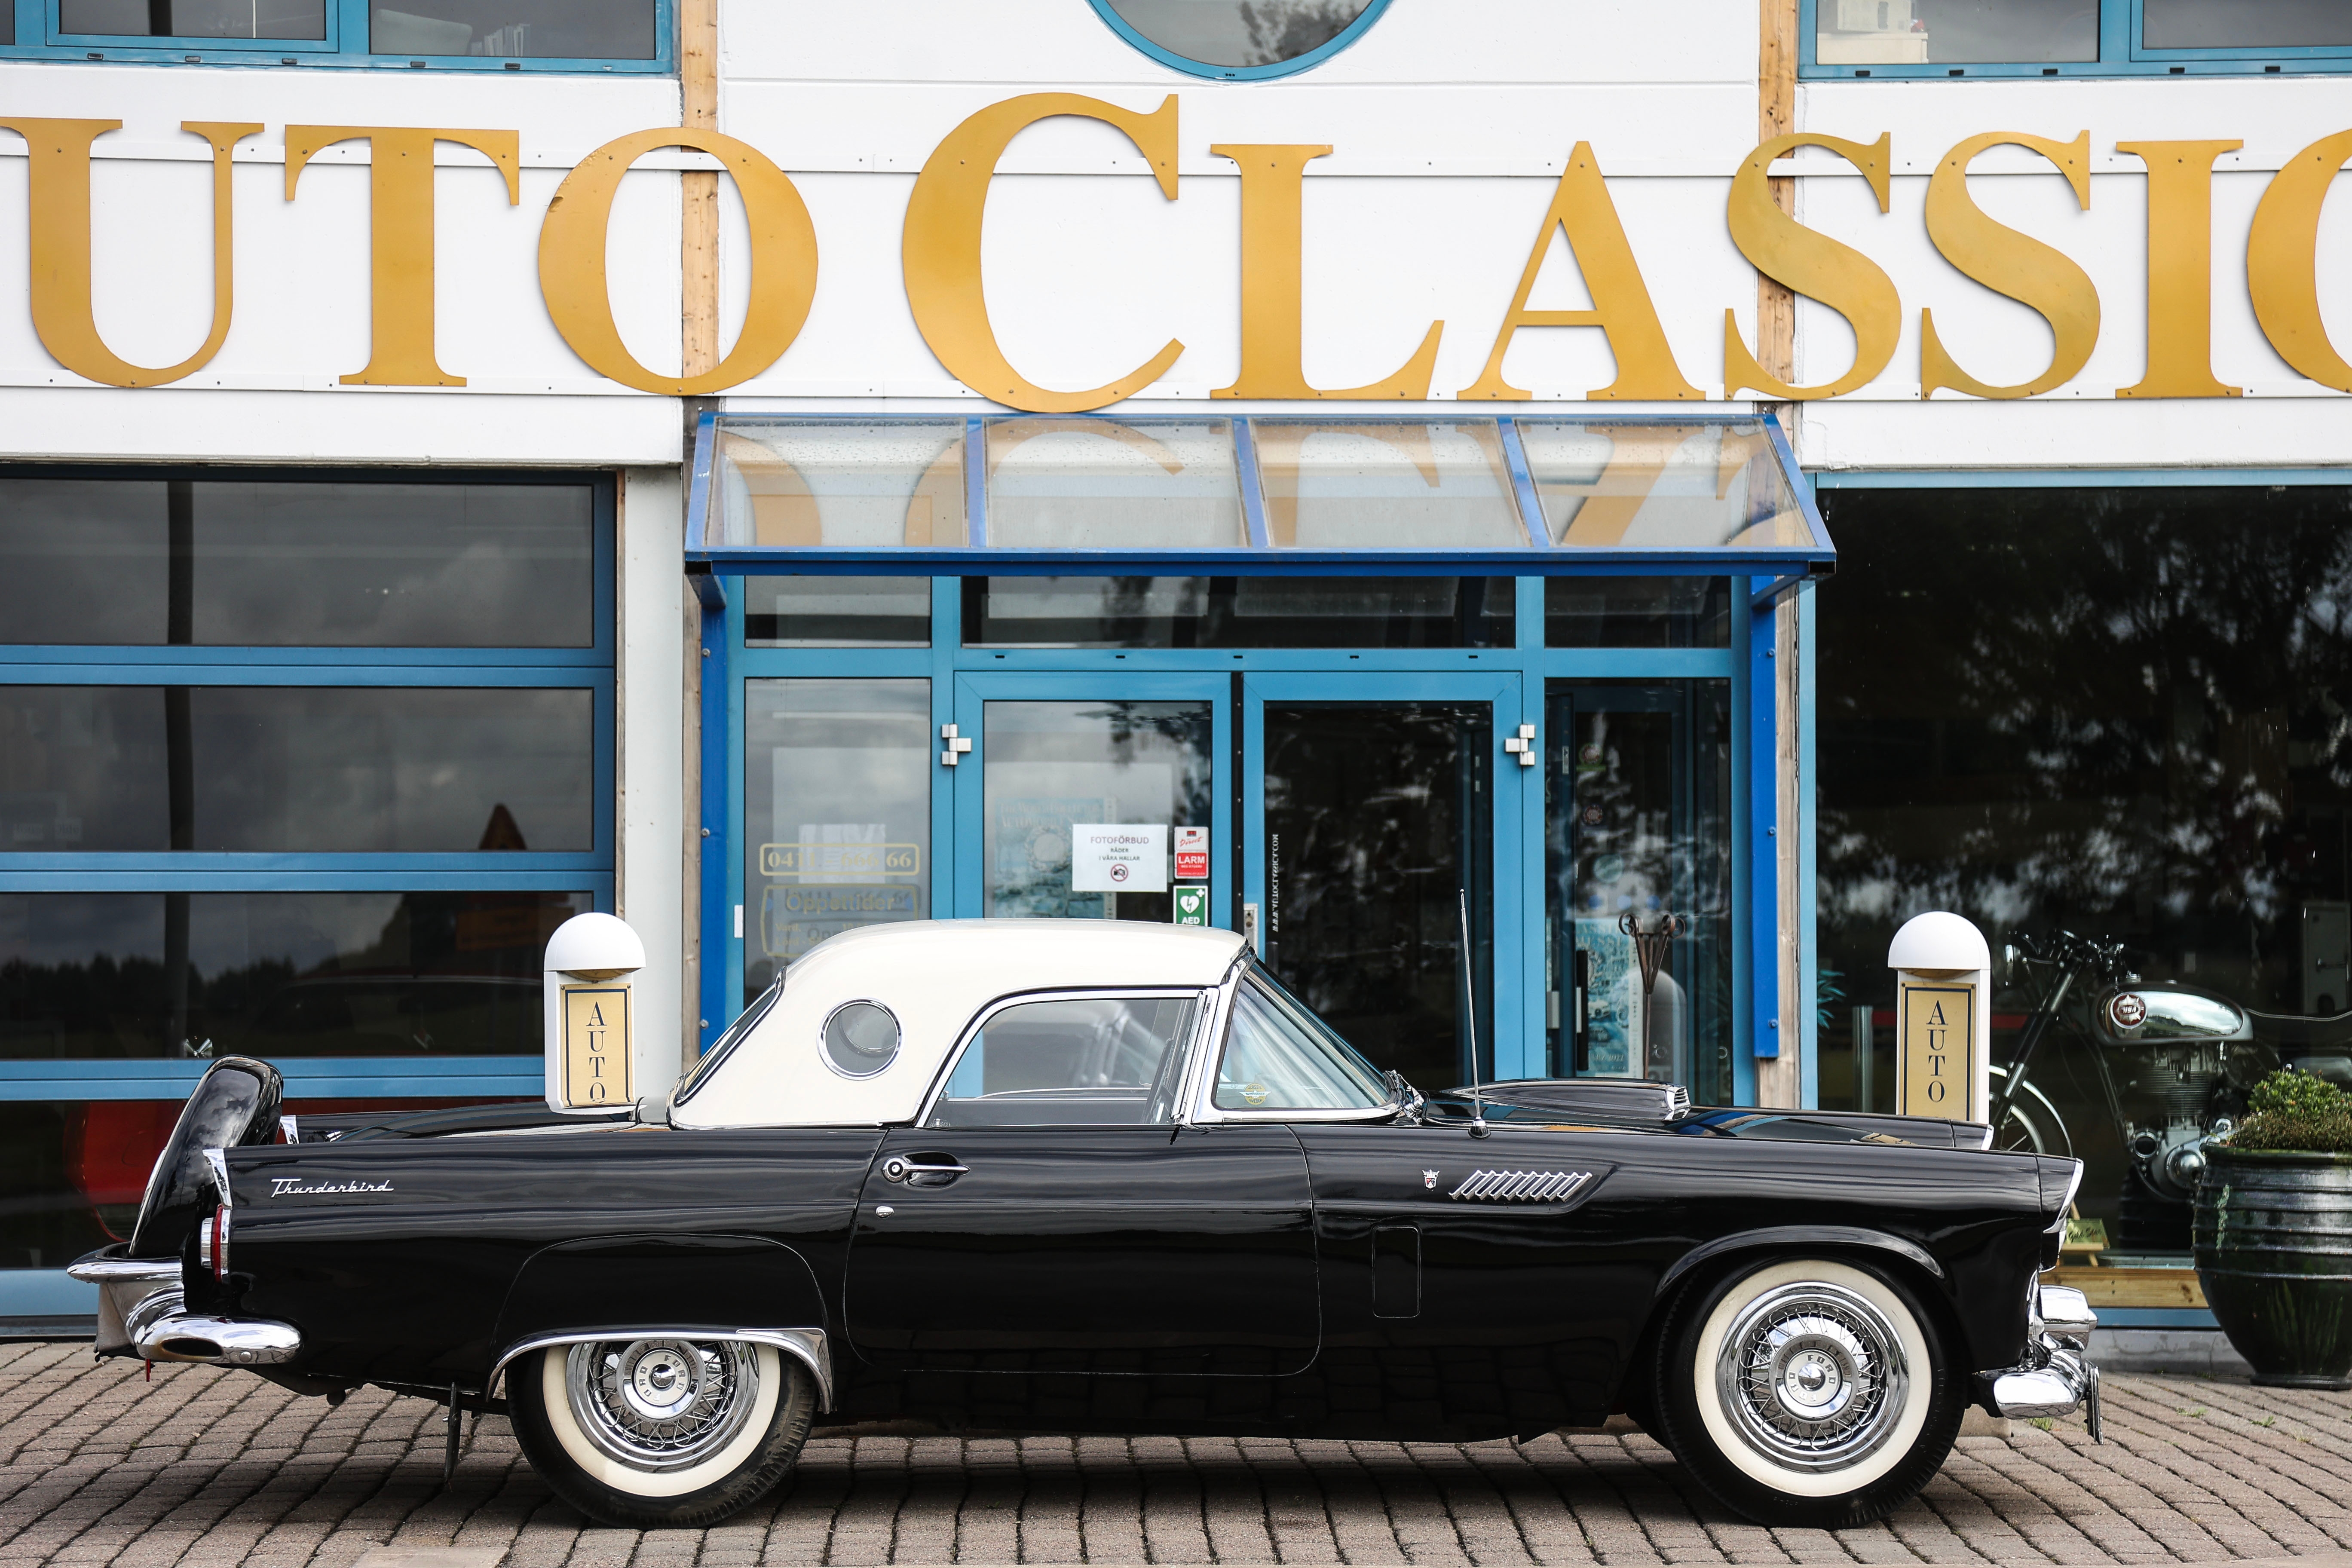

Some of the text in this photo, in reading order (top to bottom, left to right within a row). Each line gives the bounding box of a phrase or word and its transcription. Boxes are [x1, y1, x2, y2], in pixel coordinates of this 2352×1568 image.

[1090, 836, 1149, 844] FOTOFÖRBUD
[1180, 836, 1203, 847] Direct
[768, 851, 815, 868] 0411
[841, 851, 879, 868] 666
[886, 851, 912, 868] 66
[1178, 856, 1205, 864] LARM
[786, 892, 895, 914] Öppettider
[1182, 916, 1200, 925] AED
[586, 1001, 607, 1100] AUTO
[1926, 1000, 1948, 1103] AUTO
[271, 1178, 394, 1198] Thunderbird
[1807, 1354, 1836, 1384] FORD
